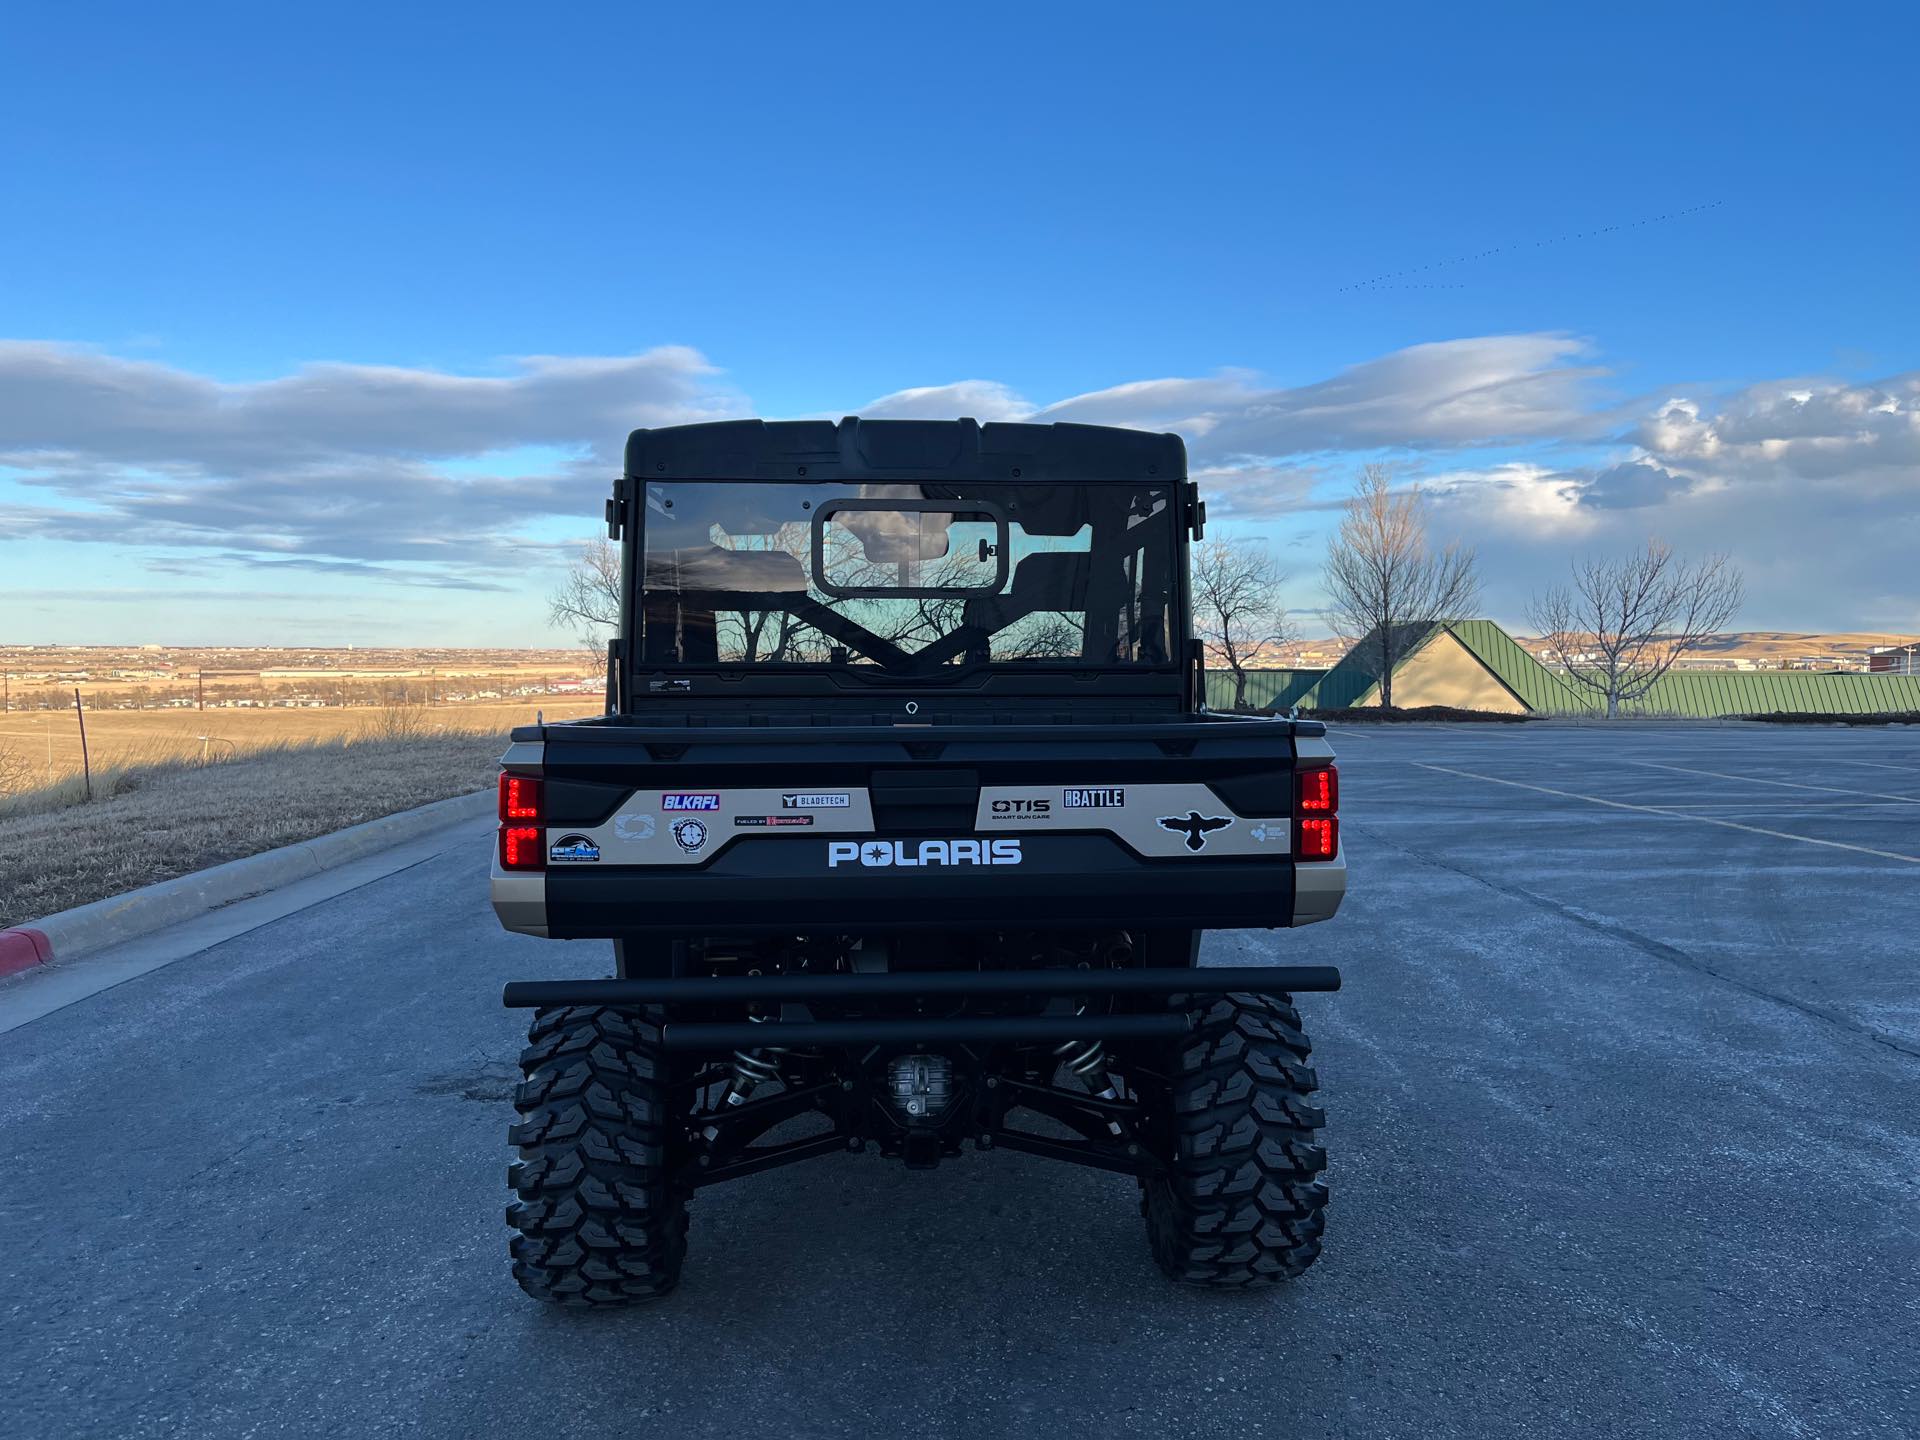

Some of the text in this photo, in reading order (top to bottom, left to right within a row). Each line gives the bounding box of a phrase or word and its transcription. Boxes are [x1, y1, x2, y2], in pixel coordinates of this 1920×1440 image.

[664, 795, 719, 810] BLKRFL
[801, 796, 845, 805] BLADETECH
[1073, 790, 1121, 806] BATTLE
[992, 800, 1050, 812] OTIS
[828, 839, 1022, 867] POLARIS
